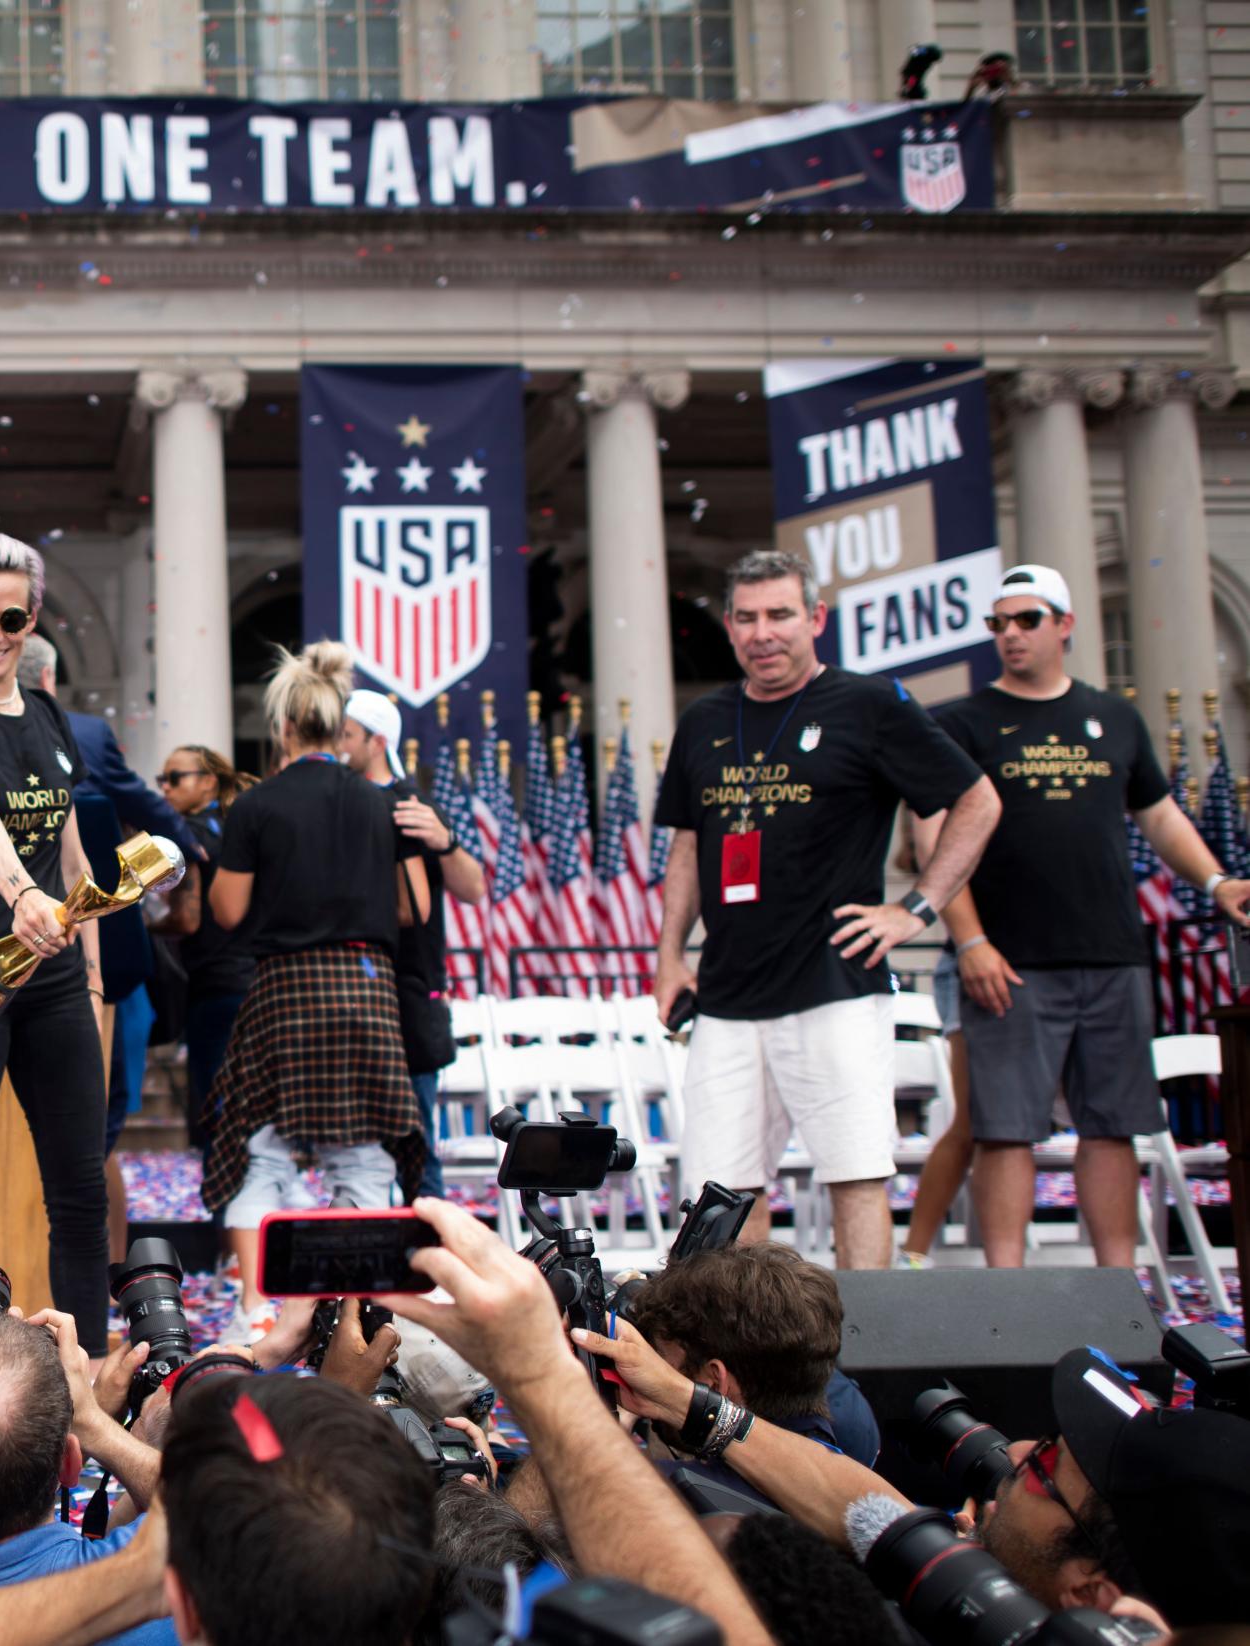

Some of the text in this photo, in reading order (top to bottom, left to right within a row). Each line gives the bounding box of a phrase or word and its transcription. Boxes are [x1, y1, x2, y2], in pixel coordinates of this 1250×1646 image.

[36, 111, 211, 204] ONE
[249, 116, 528, 206] TEAM.
[908, 147, 956, 176] USA
[799, 399, 963, 497] THANK
[353, 519, 477, 588] USA
[804, 504, 902, 587] YOU
[855, 575, 969, 657] FANS
[1022, 744, 1089, 760] WORLD
[723, 764, 789, 783] WORLD
[1002, 761, 1110, 777] CHAMPIONS
[7, 789, 69, 809] WORLD
[19, 845, 35, 856] 20
